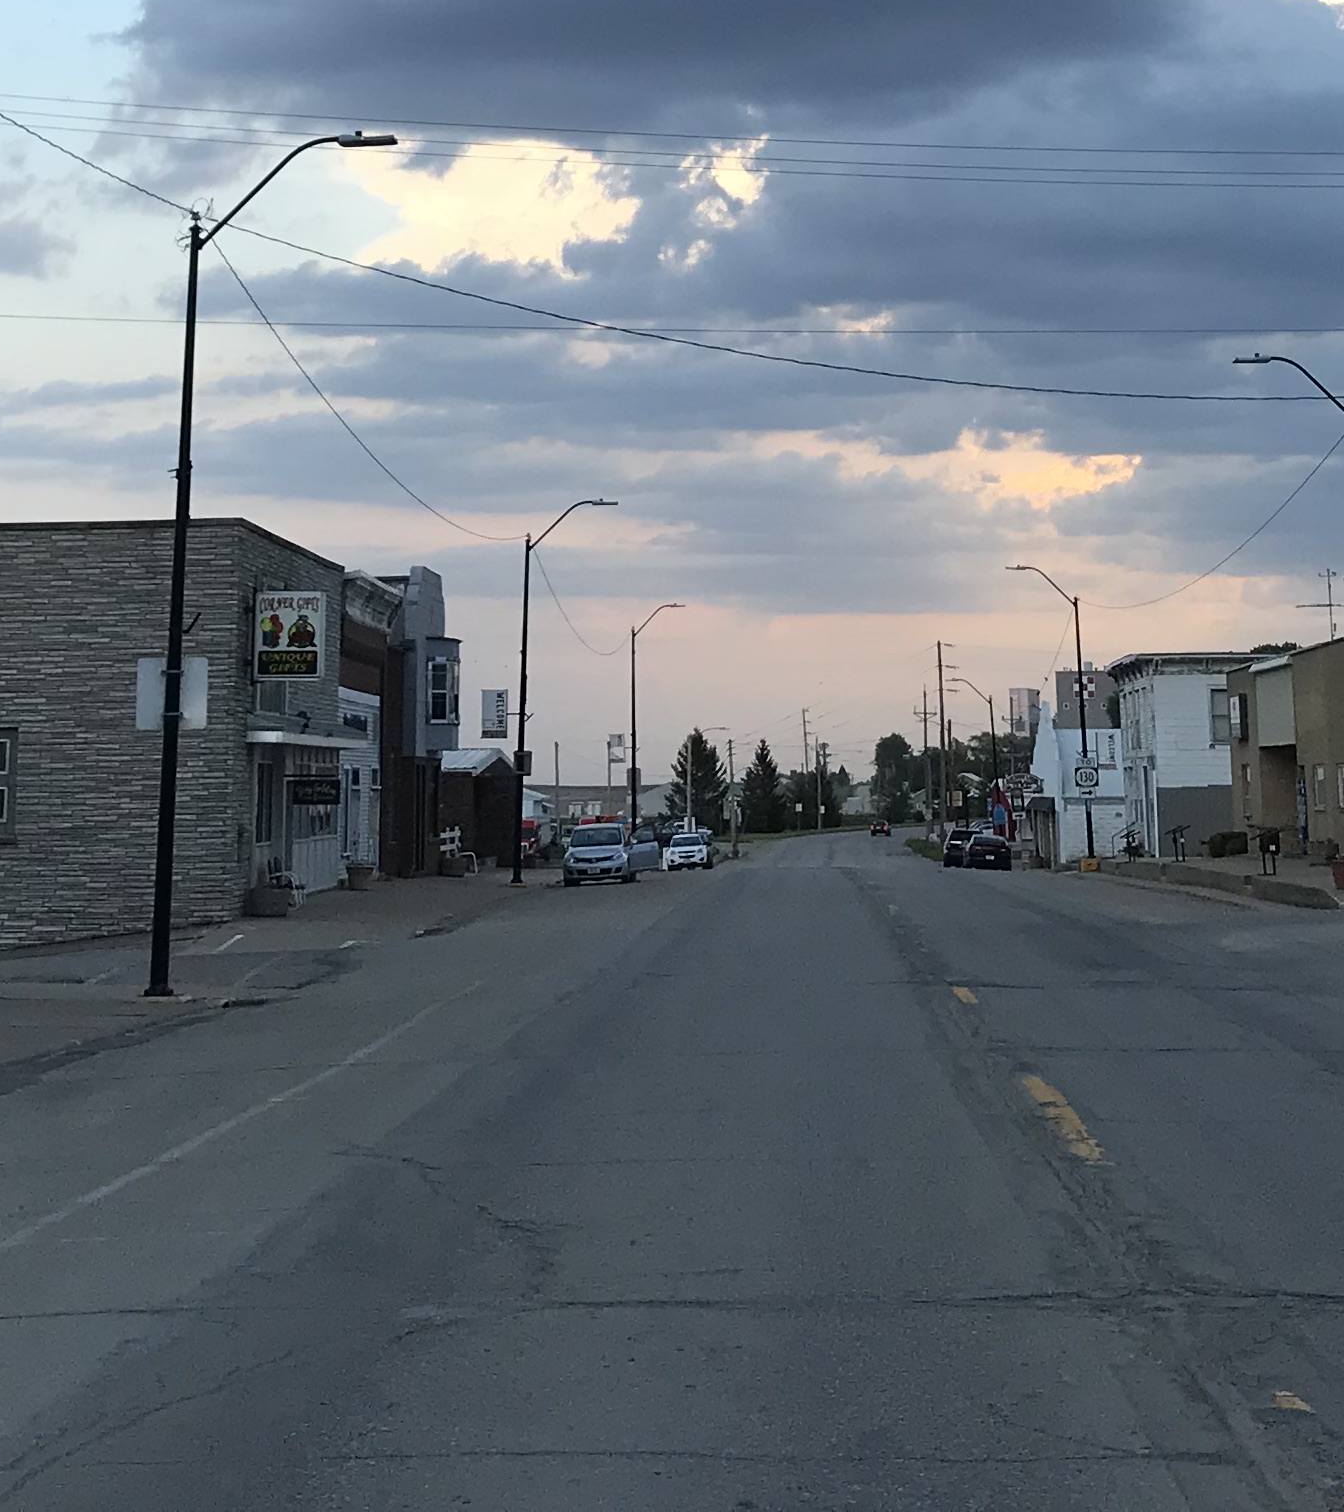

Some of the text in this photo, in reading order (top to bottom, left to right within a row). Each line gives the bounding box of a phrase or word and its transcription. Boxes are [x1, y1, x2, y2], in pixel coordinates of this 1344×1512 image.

[261, 652, 316, 663] UNIQUE
[496, 692, 505, 729] WELCOME
[1079, 770, 1095, 783] 130
